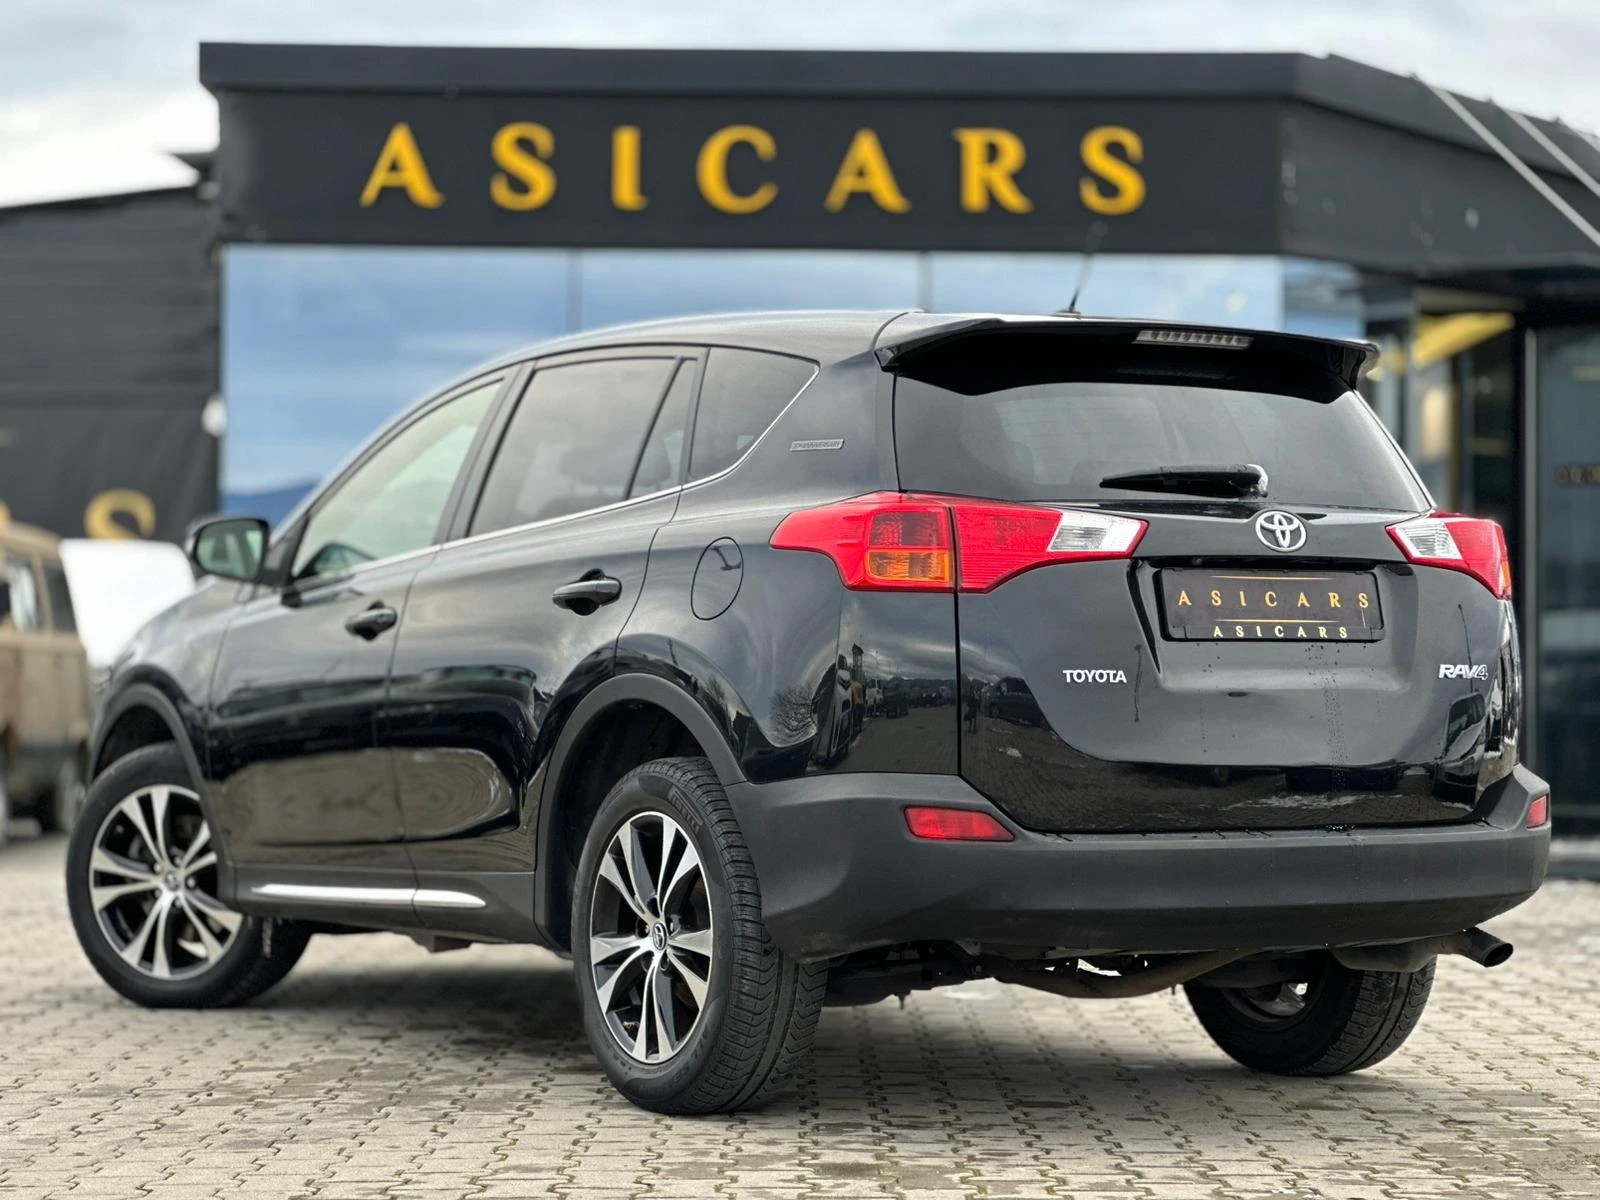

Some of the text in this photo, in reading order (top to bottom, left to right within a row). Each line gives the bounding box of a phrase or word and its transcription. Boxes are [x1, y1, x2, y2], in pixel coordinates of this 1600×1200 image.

[360, 122, 1147, 214] ASICARS
[1178, 590, 1369, 608] ASICARS
[1213, 625, 1348, 639] ASICARS
[1062, 669, 1128, 683] TOYOTA
[1438, 663, 1489, 681] RAV4
